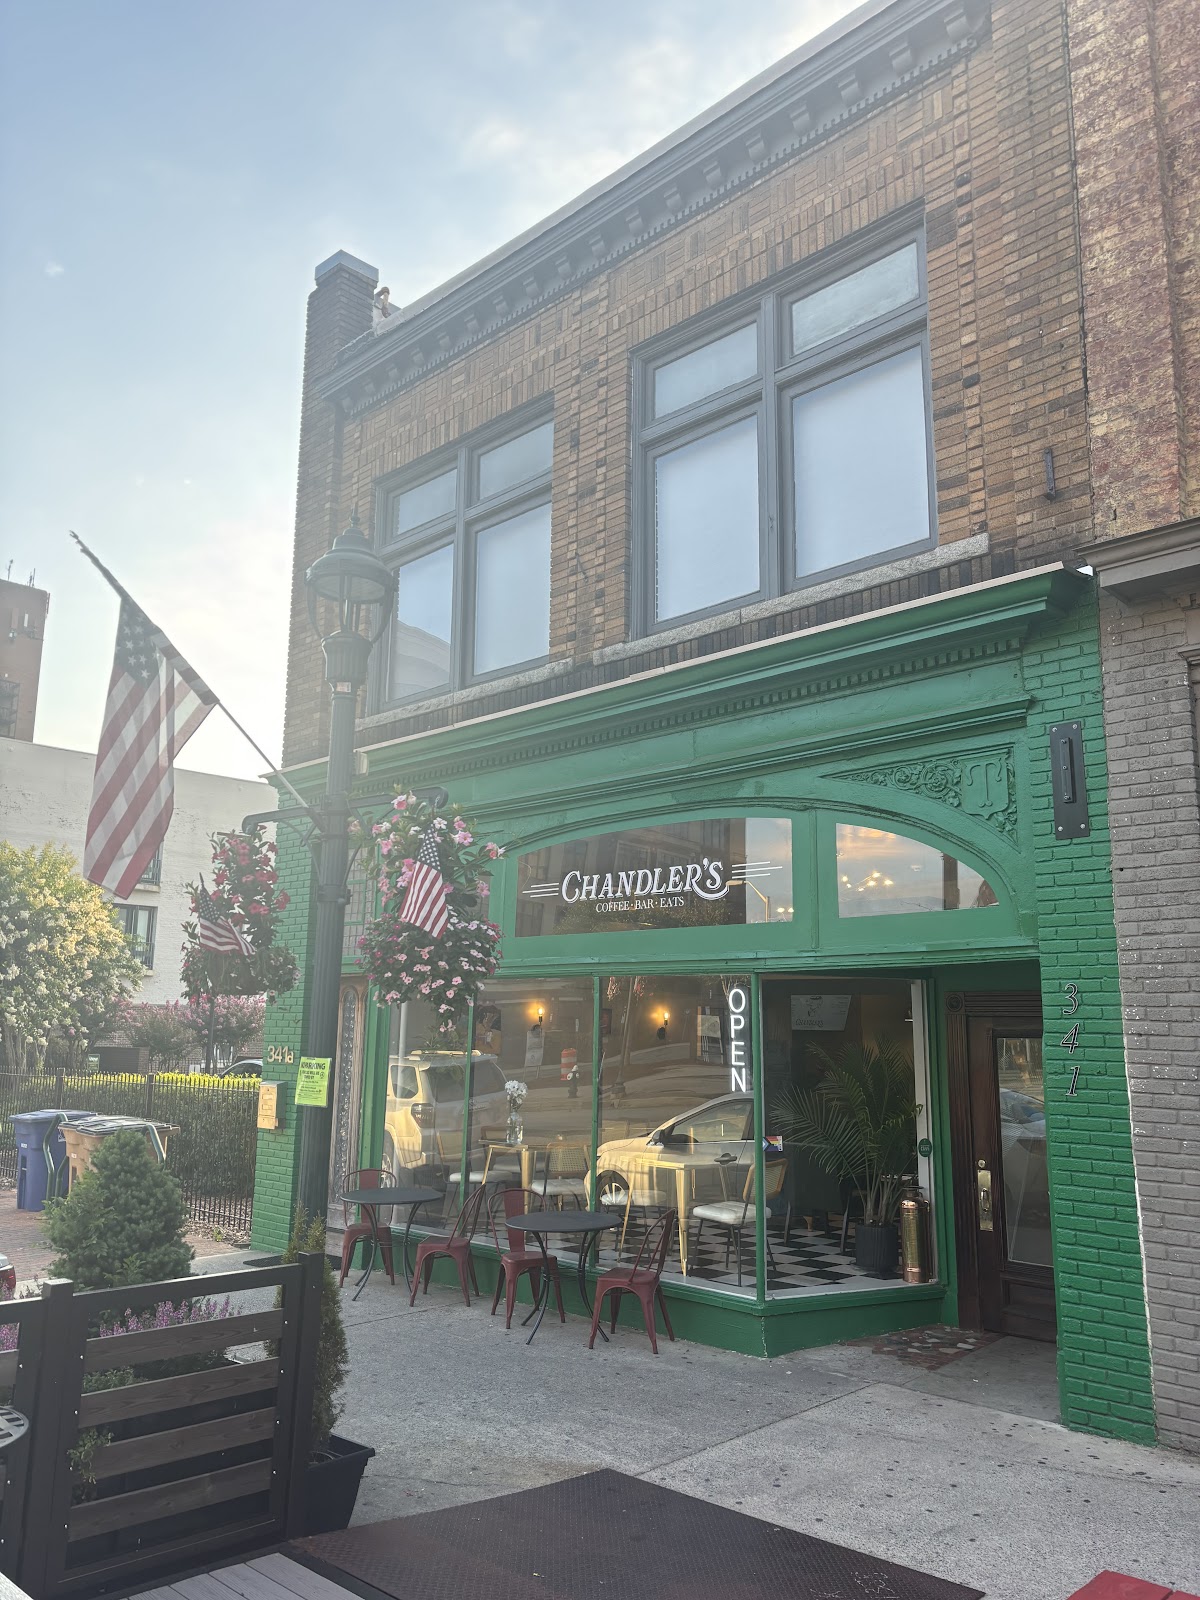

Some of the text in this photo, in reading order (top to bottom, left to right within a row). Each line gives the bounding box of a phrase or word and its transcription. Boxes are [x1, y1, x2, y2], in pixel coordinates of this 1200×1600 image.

[561, 857, 729, 904] CHANDLER'S
[596, 896, 685, 913] COFFEE BAR EATS
[267, 1045, 294, 1063] 341a
[728, 988, 747, 1093] OPEN
